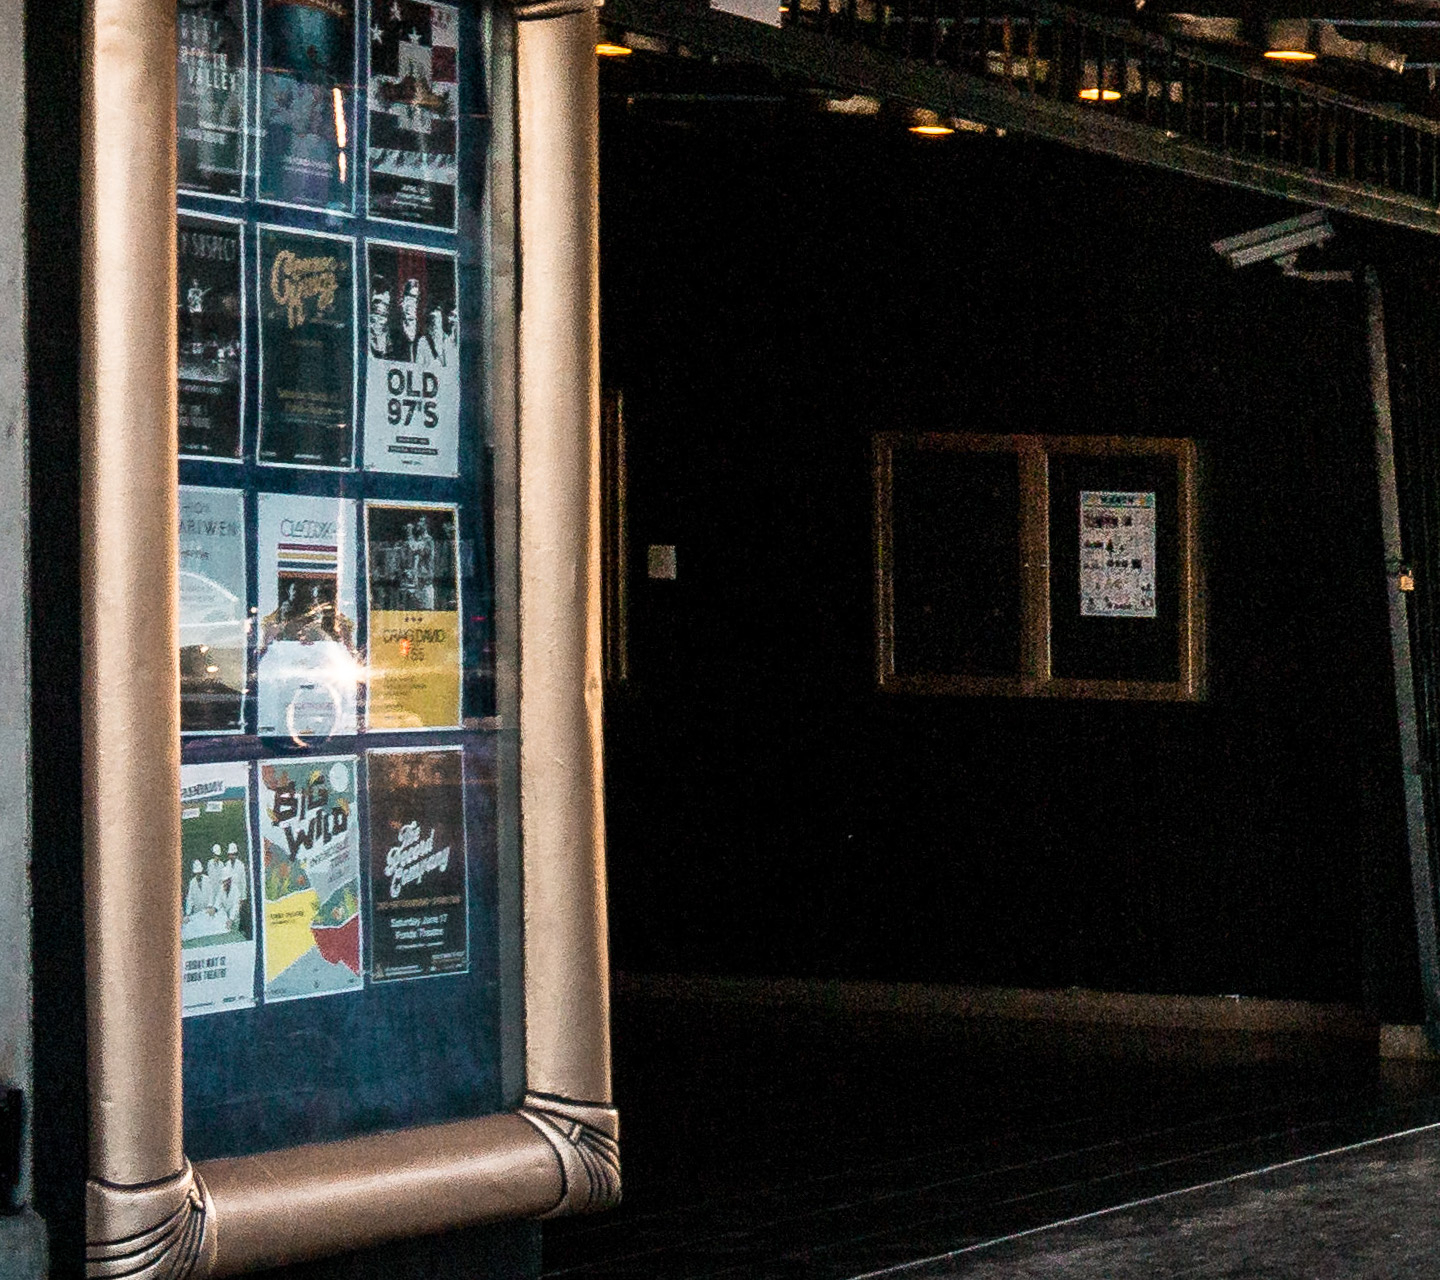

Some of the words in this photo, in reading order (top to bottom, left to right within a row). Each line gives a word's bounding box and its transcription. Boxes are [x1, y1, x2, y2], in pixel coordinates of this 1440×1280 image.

[387, 368, 439, 397] OLD
[387, 399, 439, 429] 97'S
[272, 772, 329, 827] BIG
[284, 807, 348, 862] WILD
